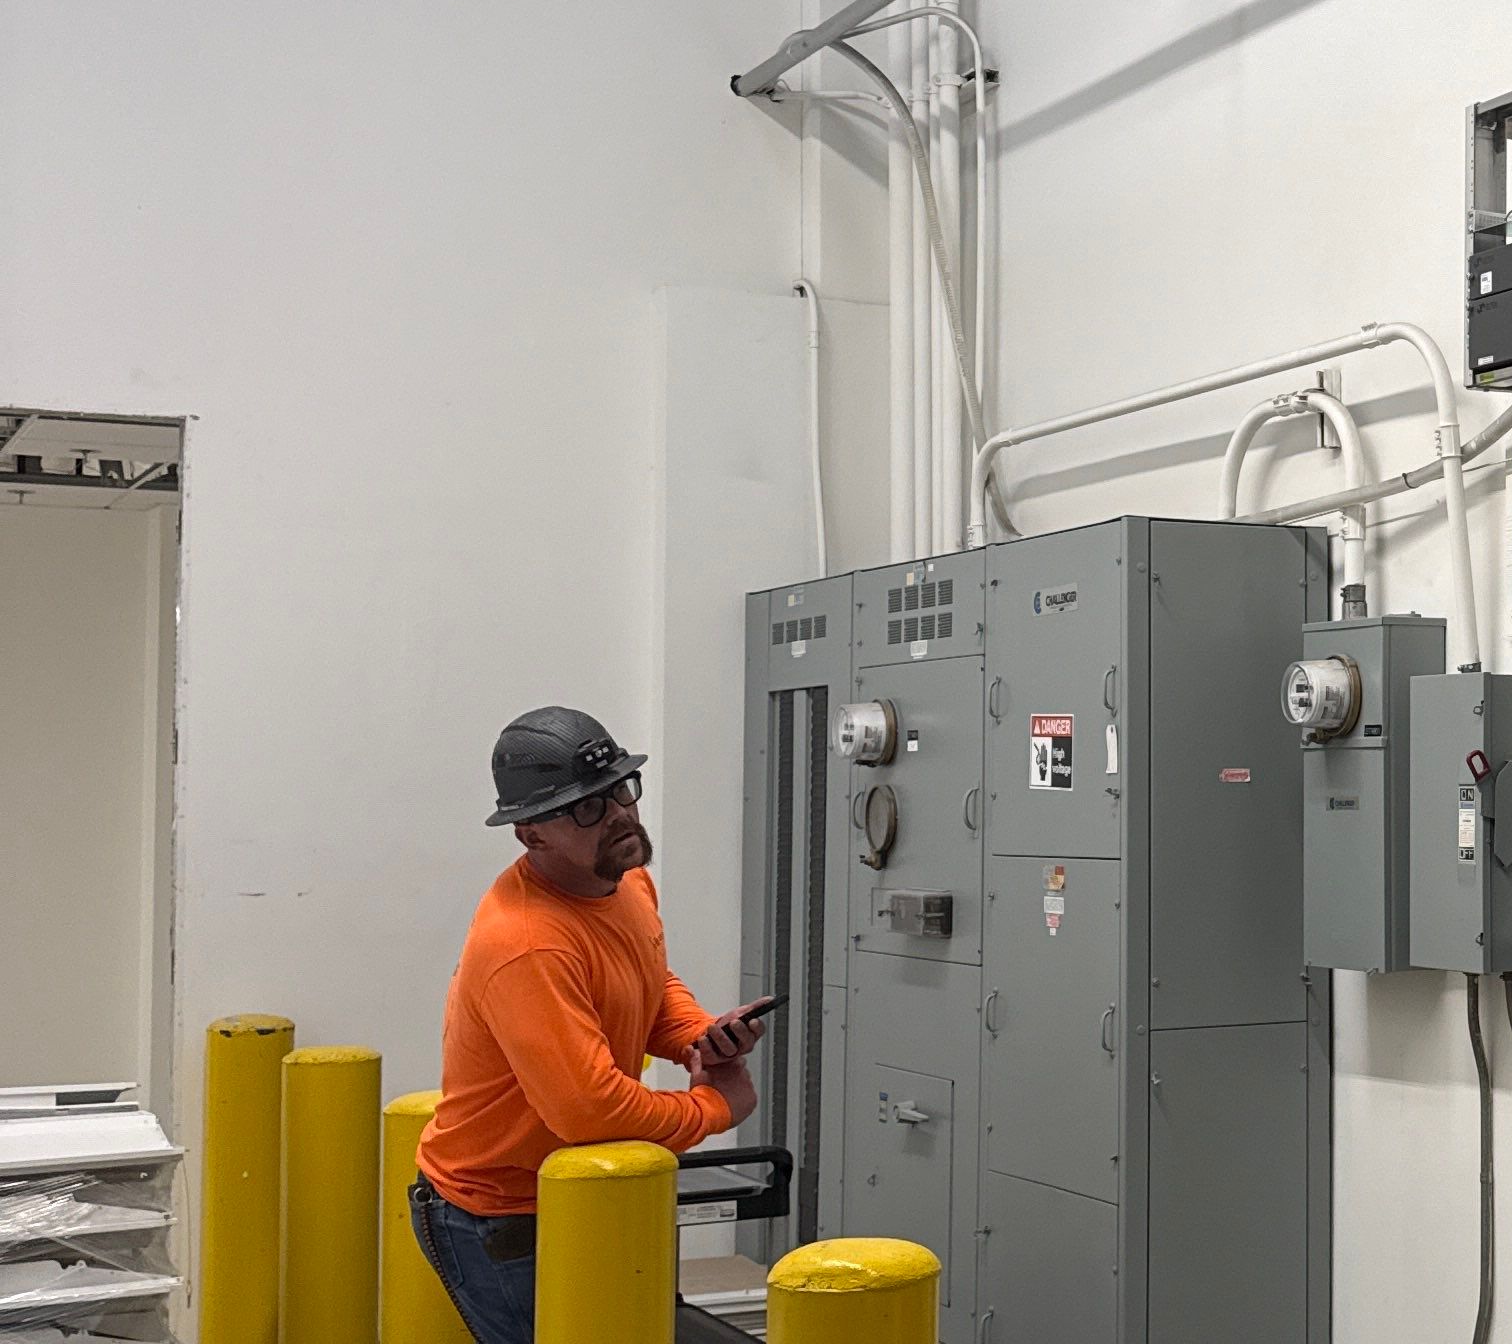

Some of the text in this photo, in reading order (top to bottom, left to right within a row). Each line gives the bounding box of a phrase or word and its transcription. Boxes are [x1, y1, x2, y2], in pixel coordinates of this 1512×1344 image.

[1041, 719, 1071, 735] DANGER
[1052, 747, 1065, 762] High
[1051, 762, 1072, 777] voltage
[1460, 789, 1474, 800] ON
[1460, 849, 1475, 859] OFF
